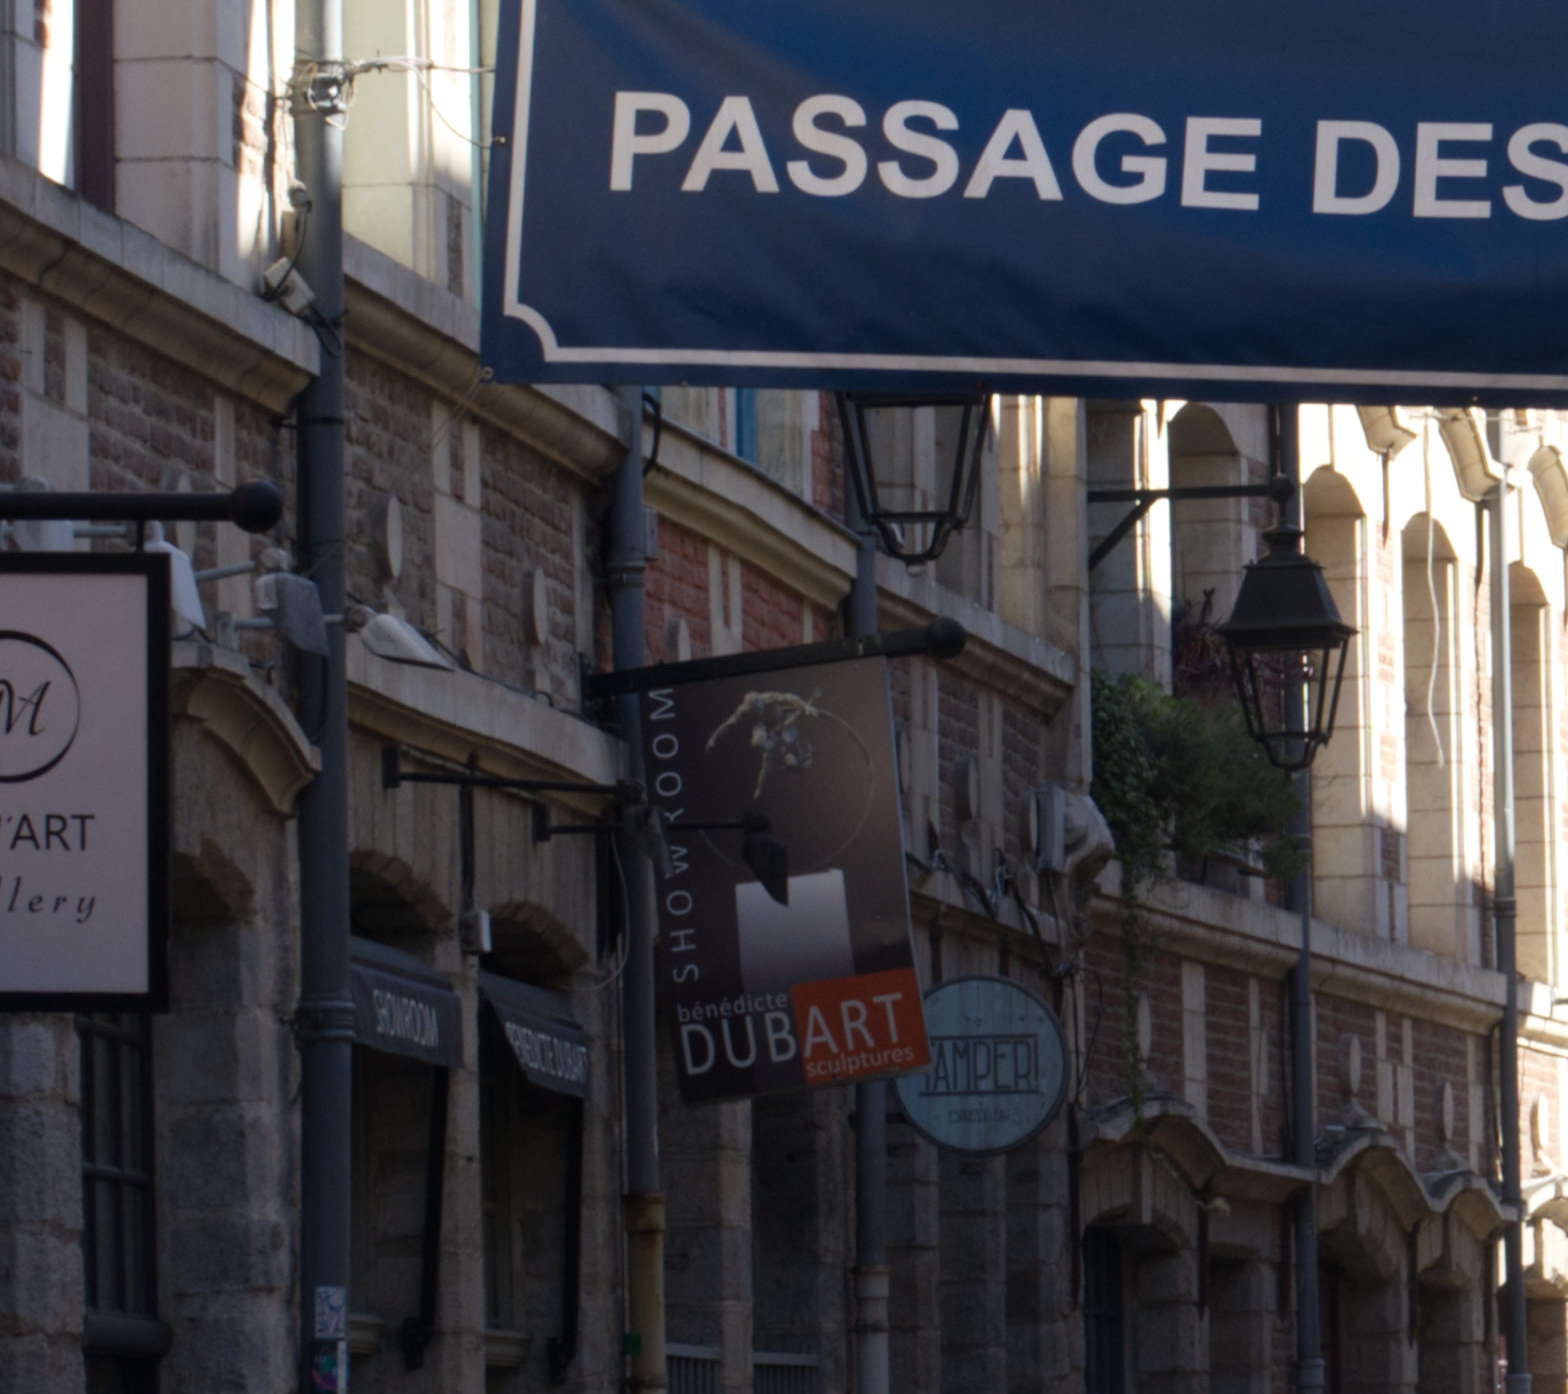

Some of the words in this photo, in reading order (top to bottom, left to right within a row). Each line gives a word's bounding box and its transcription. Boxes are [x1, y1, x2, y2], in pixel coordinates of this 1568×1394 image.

[606, 89, 1261, 214] PASSAGE
[676, 992, 789, 1024] bénédicte
[679, 992, 905, 1077] DUBART
[805, 1044, 916, 1080] sculptures
